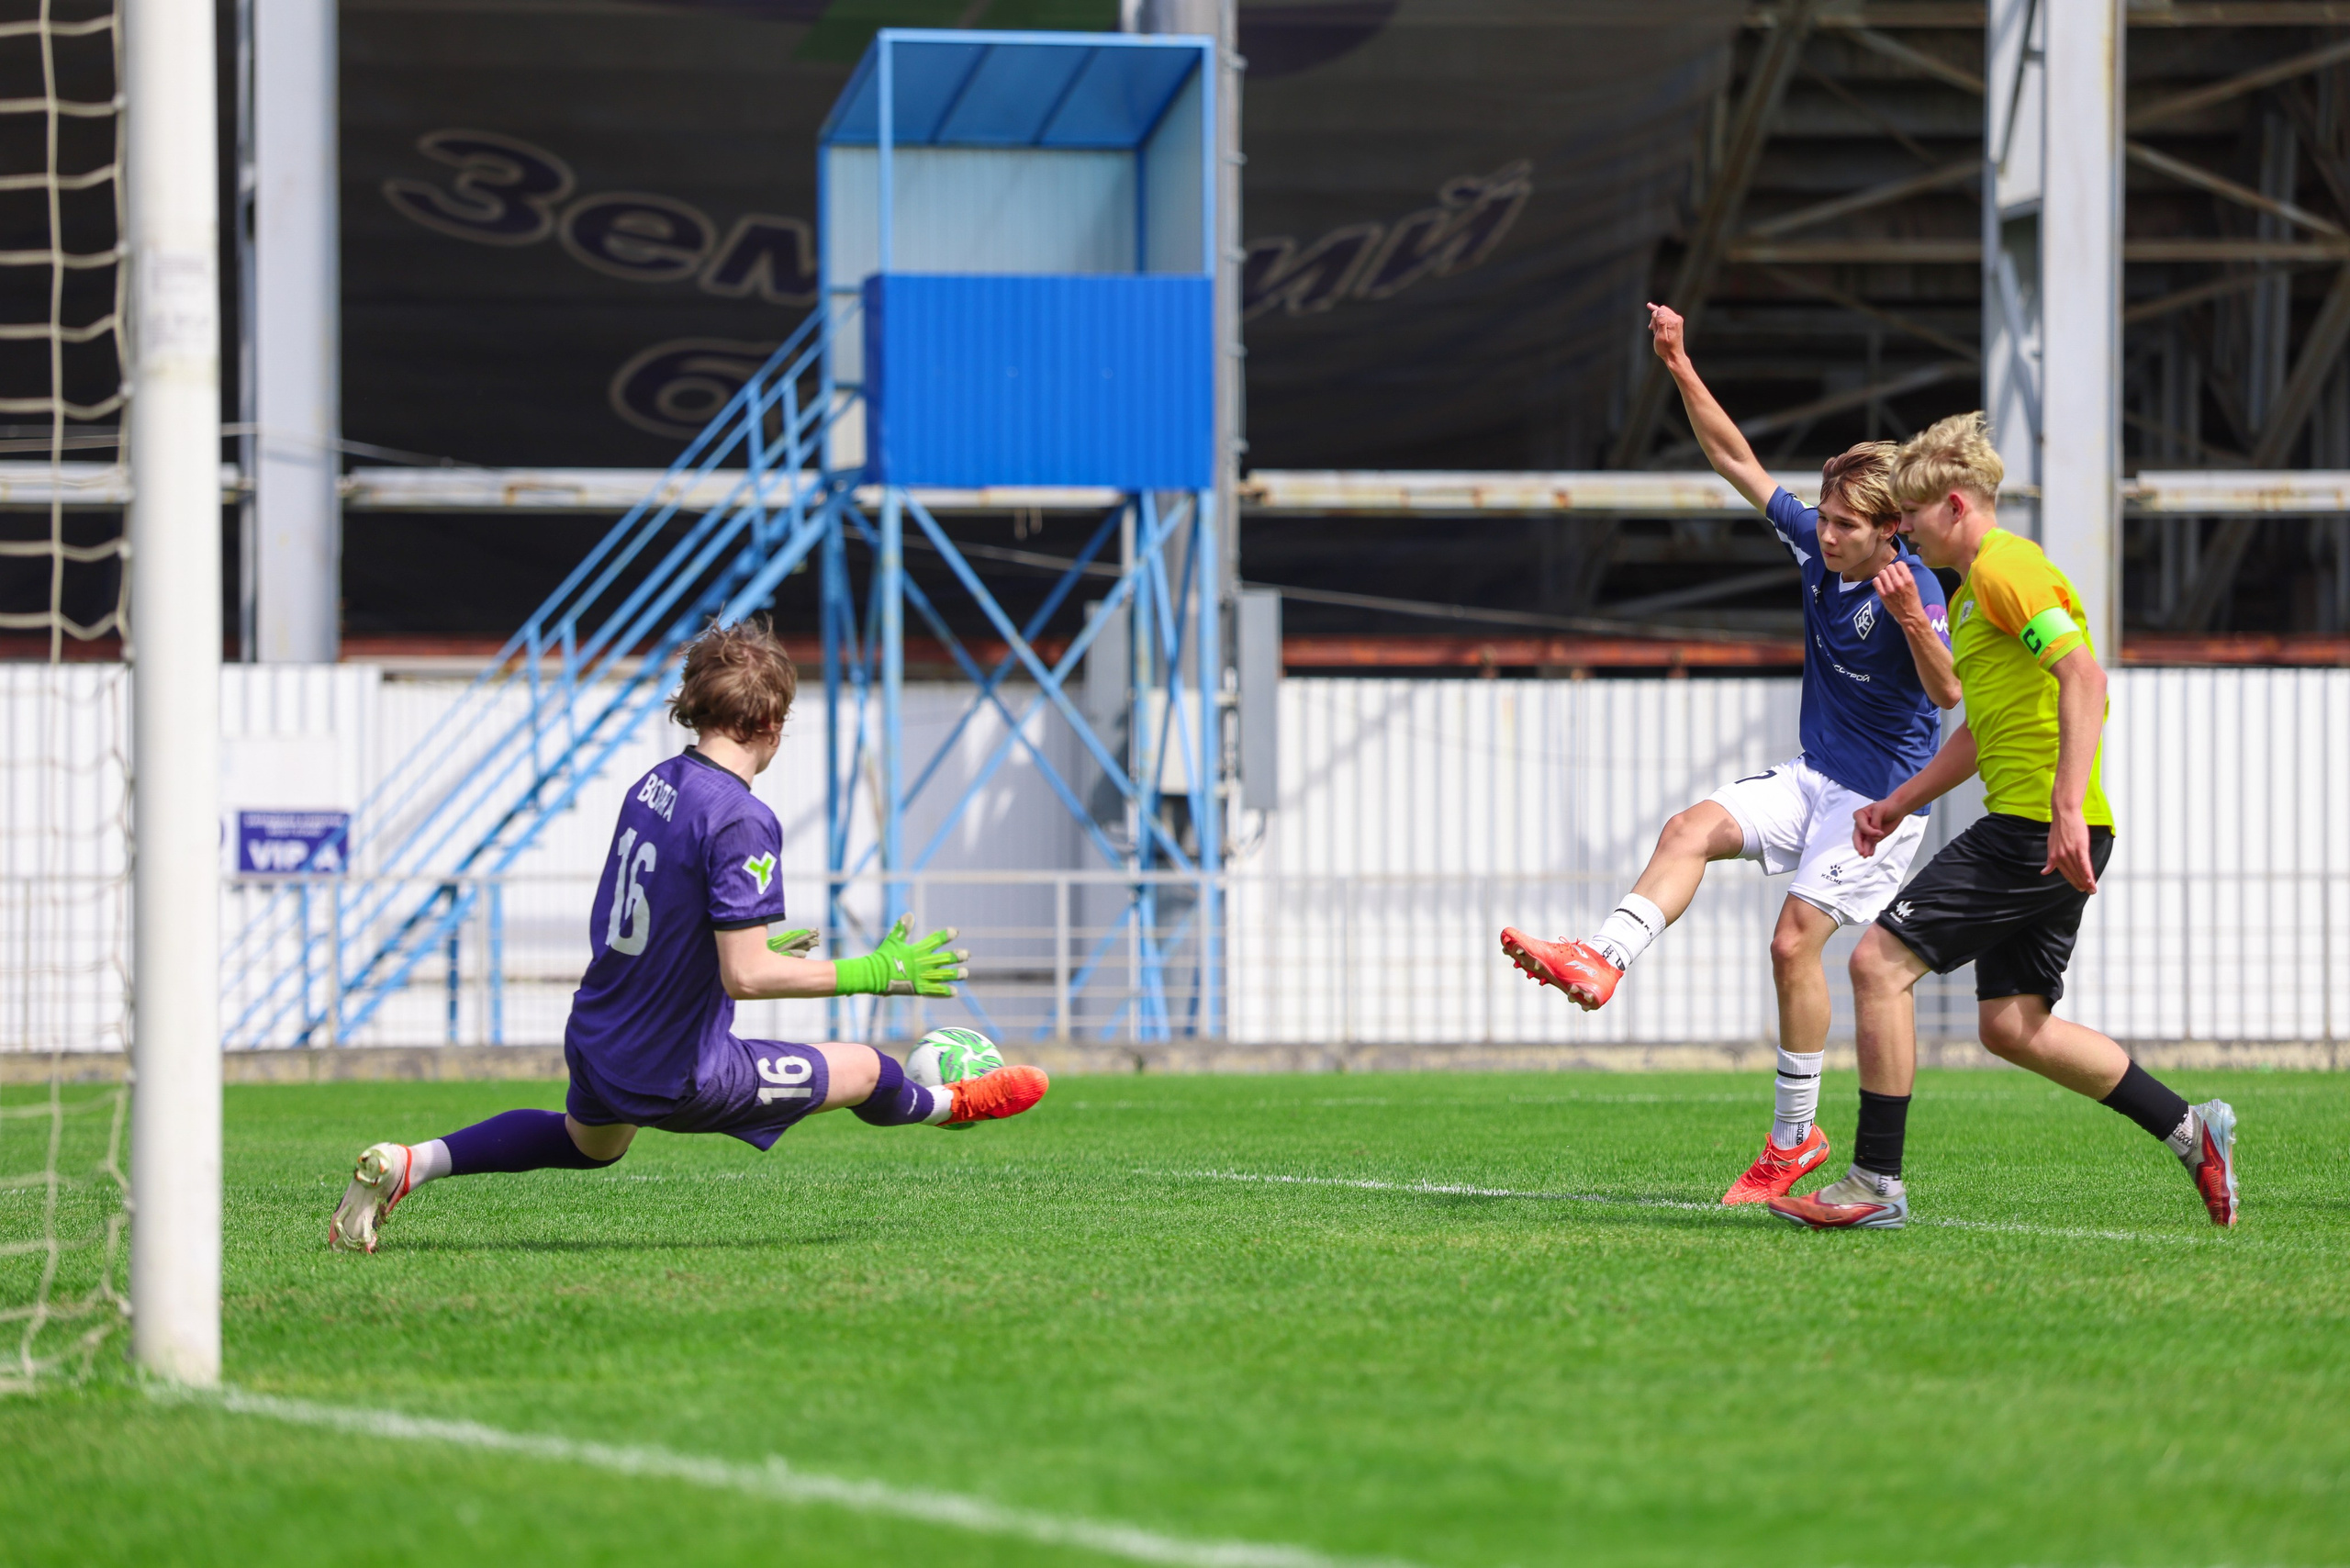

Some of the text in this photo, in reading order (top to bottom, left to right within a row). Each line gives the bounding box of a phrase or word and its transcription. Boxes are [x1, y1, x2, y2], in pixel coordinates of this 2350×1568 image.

[2022, 627, 2042, 655] C
[246, 838, 310, 871] VIP
[605, 826, 657, 957] 16
[1820, 872, 1843, 886] KELME
[757, 1054, 813, 1105] 16
